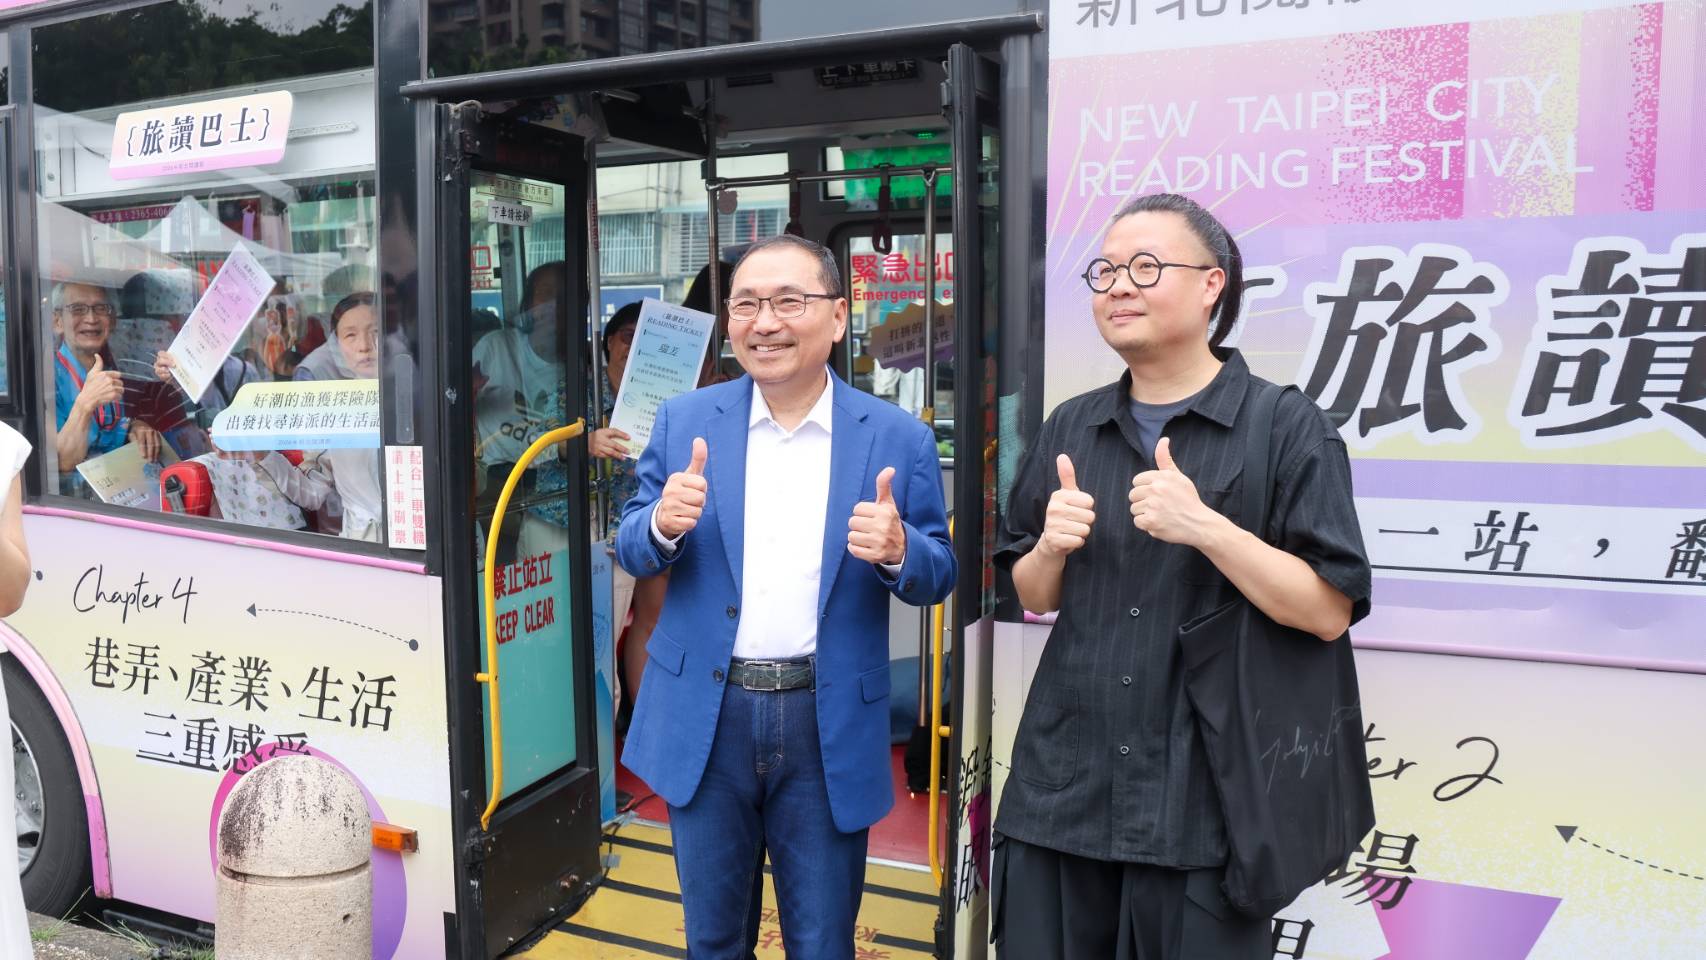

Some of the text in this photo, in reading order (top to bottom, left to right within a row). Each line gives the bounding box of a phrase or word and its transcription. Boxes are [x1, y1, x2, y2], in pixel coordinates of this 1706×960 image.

[127, 106, 270, 157] {旅讀巴士}
[1079, 73, 1560, 143] NEW TAIPEI CITY
[1079, 134, 1595, 197] READING FESTIVAL
[853, 288, 926, 304] Emergenc
[73, 563, 198, 624] Chapter 4
[524, 596, 555, 634] CLEAR
[83, 636, 398, 732] 巷弄、產業、生活
[1432, 736, 1504, 802] 2
